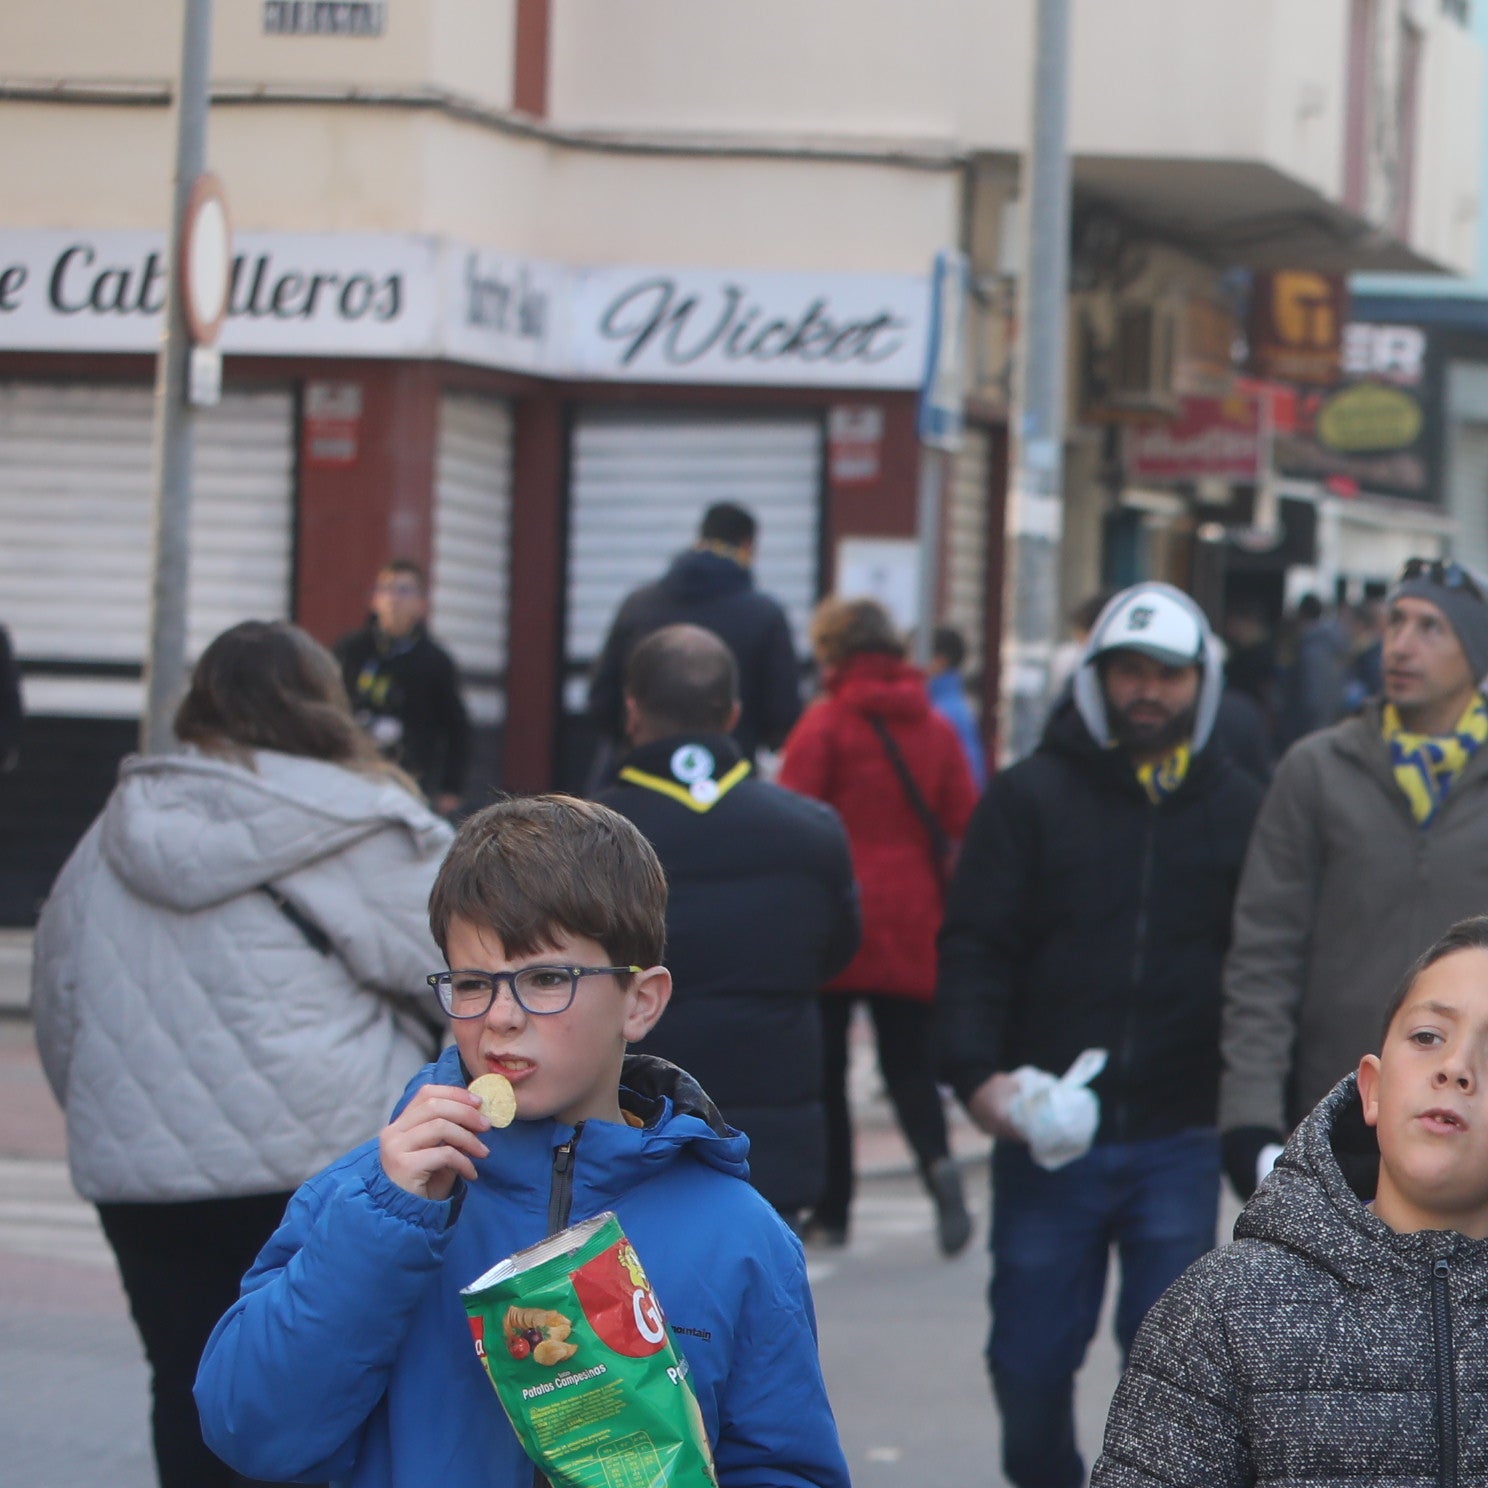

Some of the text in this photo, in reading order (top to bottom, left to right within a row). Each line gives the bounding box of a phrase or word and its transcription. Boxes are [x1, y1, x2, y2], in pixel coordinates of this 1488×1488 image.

[600, 276, 908, 368] Wicket
[522, 1363, 607, 1400] Patatas Campesinas
